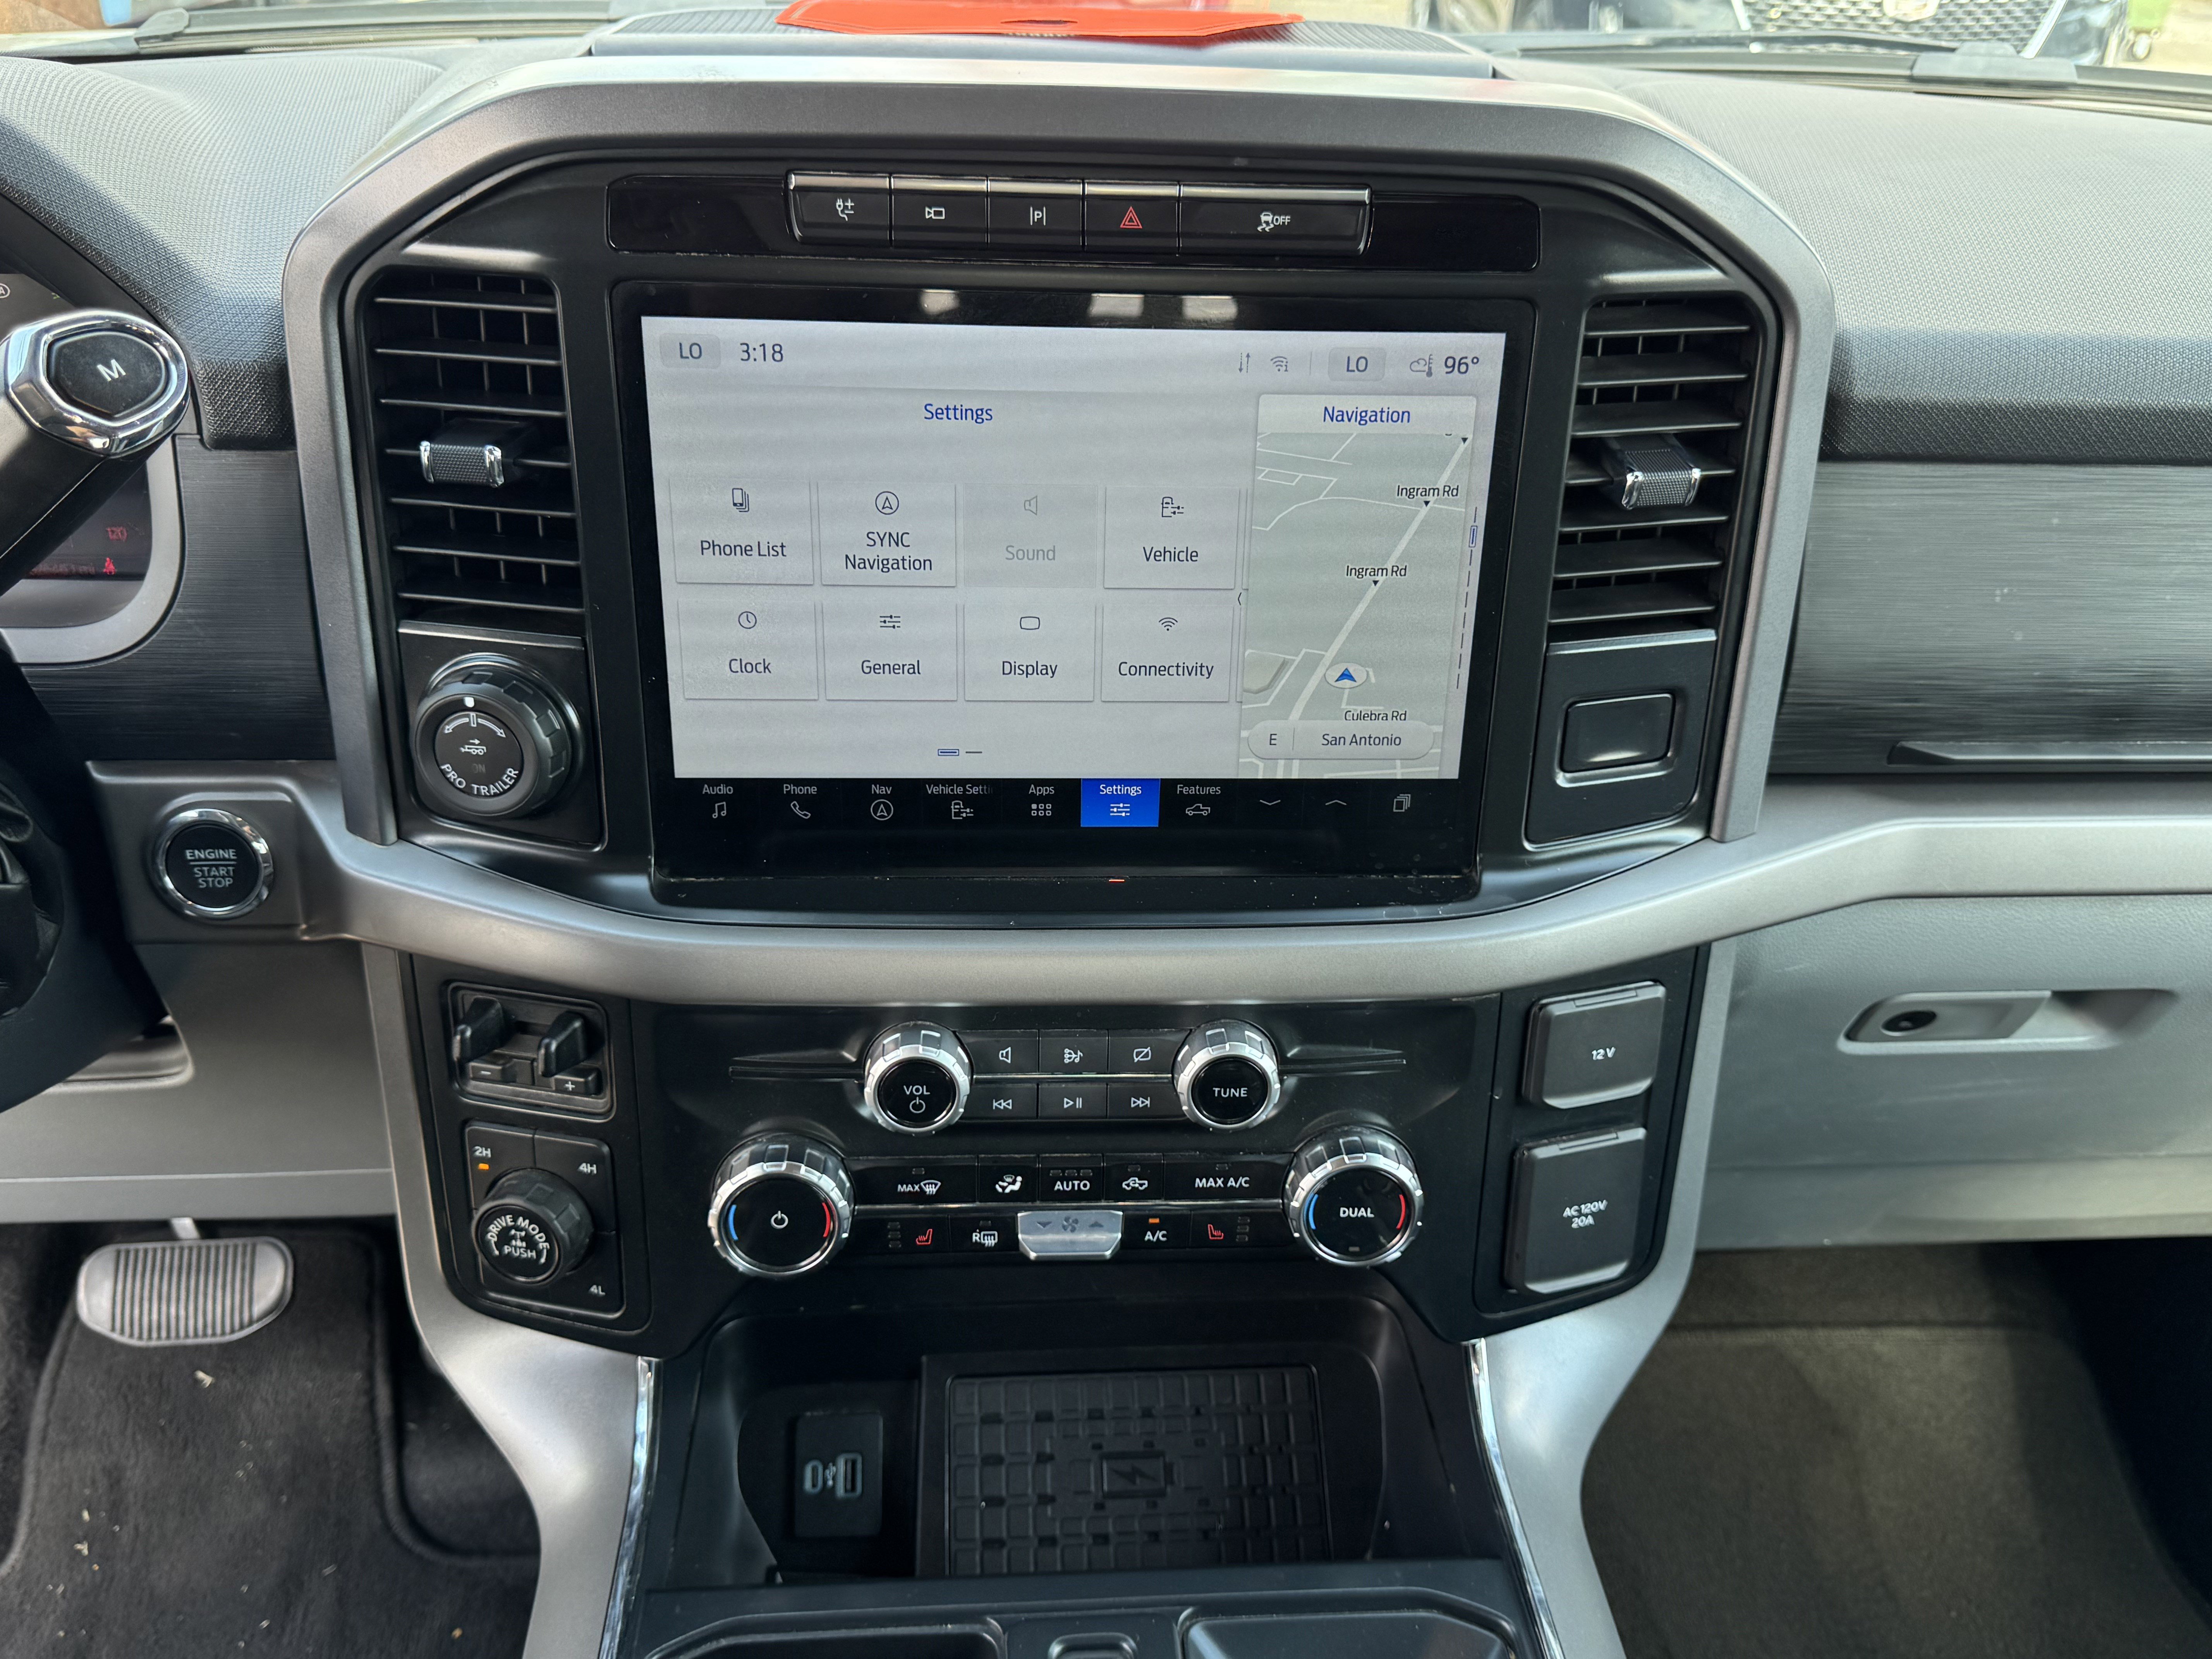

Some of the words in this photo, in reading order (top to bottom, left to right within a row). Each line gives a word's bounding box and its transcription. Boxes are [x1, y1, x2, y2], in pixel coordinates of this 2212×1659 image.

[1273, 215, 1291, 225] OFF
[679, 342, 702, 359] LO
[740, 342, 784, 362] 3:18
[96, 359, 126, 382] M
[1346, 356, 1369, 373] LO
[1444, 356, 1480, 375] 96°
[924, 403, 993, 424] Settings
[1323, 406, 1411, 426] Navigation
[1396, 485, 1439, 499] Ingram
[1442, 485, 1459, 497] Rd
[866, 532, 911, 548] SYNC
[700, 541, 753, 558] Phone
[758, 541, 787, 558] List
[1005, 545, 1056, 562] Sound
[1143, 546, 1199, 563] Vehicle
[845, 554, 933, 574] Navigation
[1346, 565, 1388, 579] Ingram
[1391, 565, 1407, 577] Rd
[728, 658, 772, 674] Clock
[861, 659, 921, 675] General
[1002, 661, 1058, 678] Display
[1118, 662, 1214, 678] Connectivity
[1345, 710, 1388, 721] Culebra
[1391, 710, 1407, 721] Rd
[1269, 734, 1278, 746] E
[1321, 734, 1346, 746] San
[1349, 733, 1401, 746] Antonio
[440, 764, 466, 788] PRO
[471, 768, 519, 796] TRAILER
[702, 784, 733, 794] Audio
[783, 784, 817, 794] Phone
[871, 784, 892, 794] Nav
[926, 784, 963, 794] Vehicle
[1029, 784, 1054, 797] Apps
[1099, 784, 1142, 797] Settings
[1177, 784, 1221, 795] Features
[185, 849, 237, 860] ENGINE
[194, 867, 235, 878] START
[198, 878, 233, 888] STOP
[903, 1085, 930, 1095] VOL
[1213, 1087, 1248, 1097] TUNE
[473, 1146, 491, 1158] 2H
[577, 1163, 597, 1175] 4H
[898, 1184, 920, 1192] MAX
[1054, 1181, 1090, 1191] AUTO
[1195, 1178, 1223, 1188] MAX
[1227, 1177, 1250, 1188] A/C
[1340, 1207, 1374, 1218] DUAL
[1571, 1215, 1595, 1228] 20A
[485, 1214, 515, 1242] DRIVE
[516, 1217, 550, 1250] MODE
[1145, 1231, 1167, 1241] A/C
[503, 1246, 536, 1259] PUSH
[589, 1285, 605, 1296] 4L
